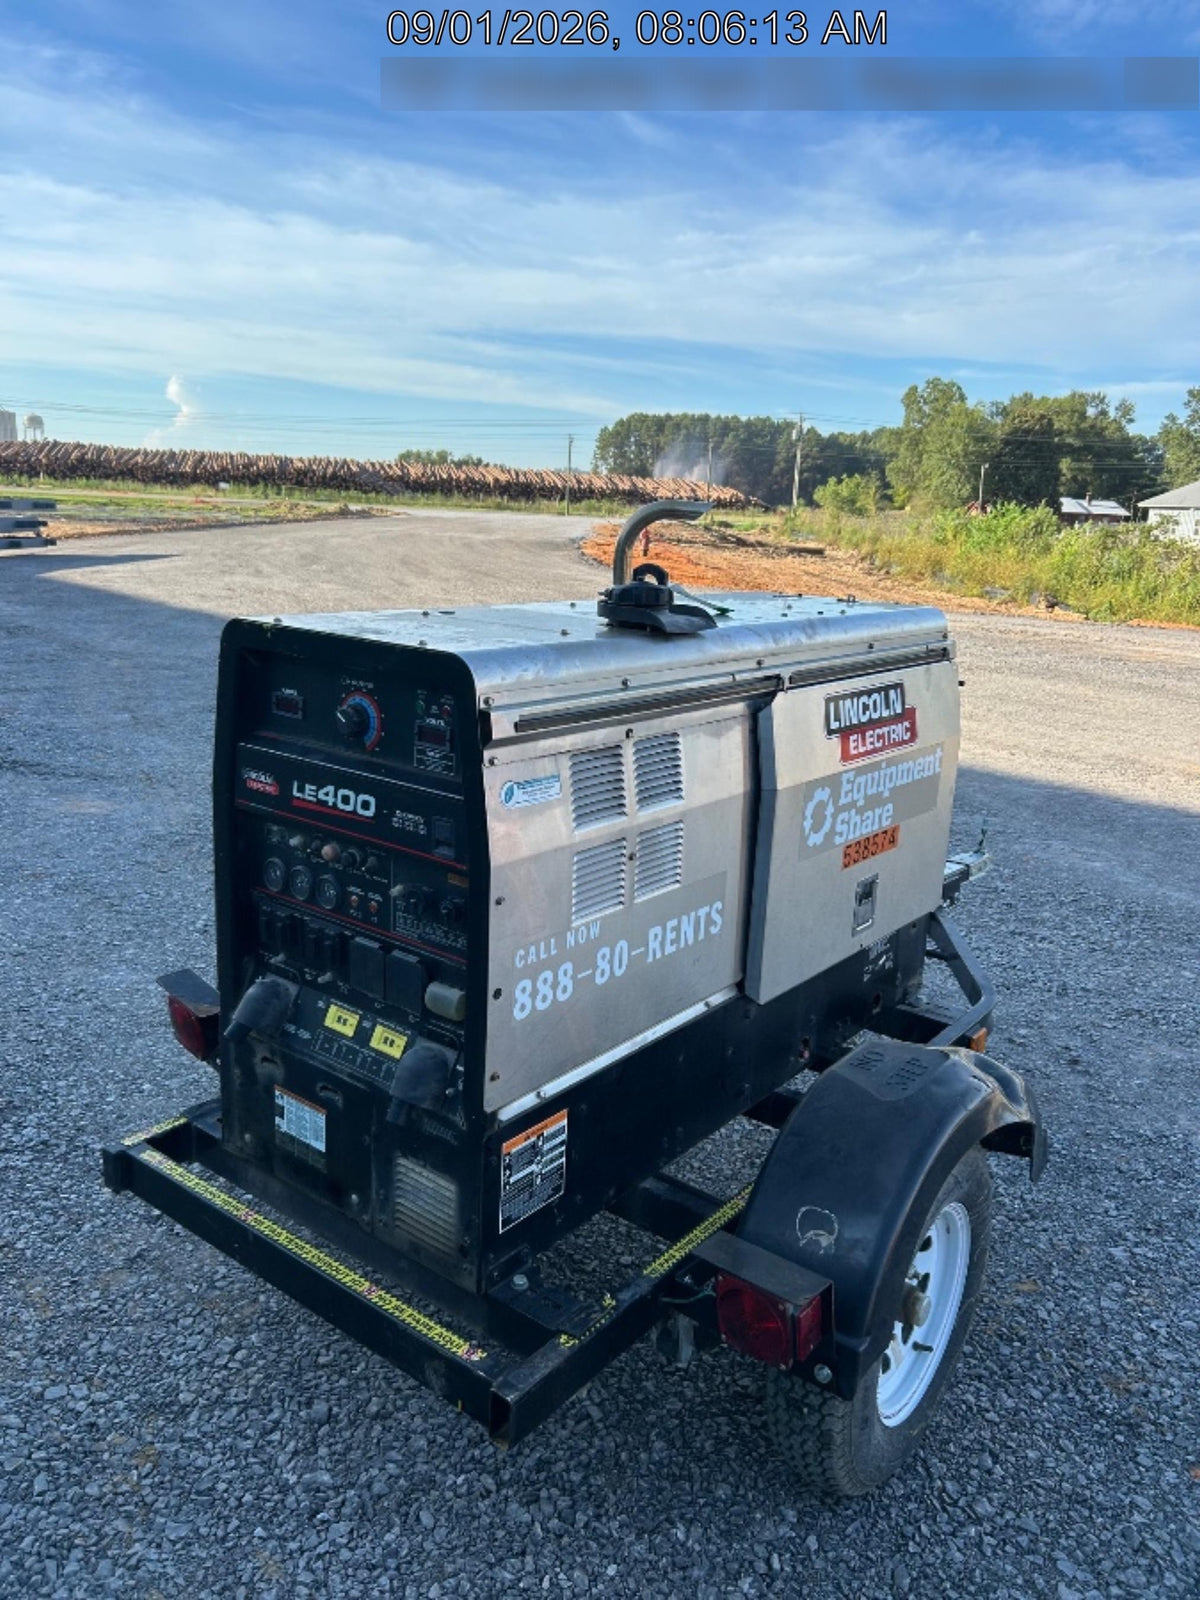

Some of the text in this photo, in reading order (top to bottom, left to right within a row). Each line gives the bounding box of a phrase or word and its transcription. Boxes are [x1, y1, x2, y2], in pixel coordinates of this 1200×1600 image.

[829, 687, 904, 732] LINCOLN
[848, 720, 912, 756] ELECTRIC
[292, 778, 377, 818] LE400
[838, 744, 943, 808] Equipment
[833, 801, 895, 846] Share
[841, 829, 898, 870] 538574
[512, 899, 723, 1021] 888-80-RENTS
[514, 920, 602, 969] CALL NOW
